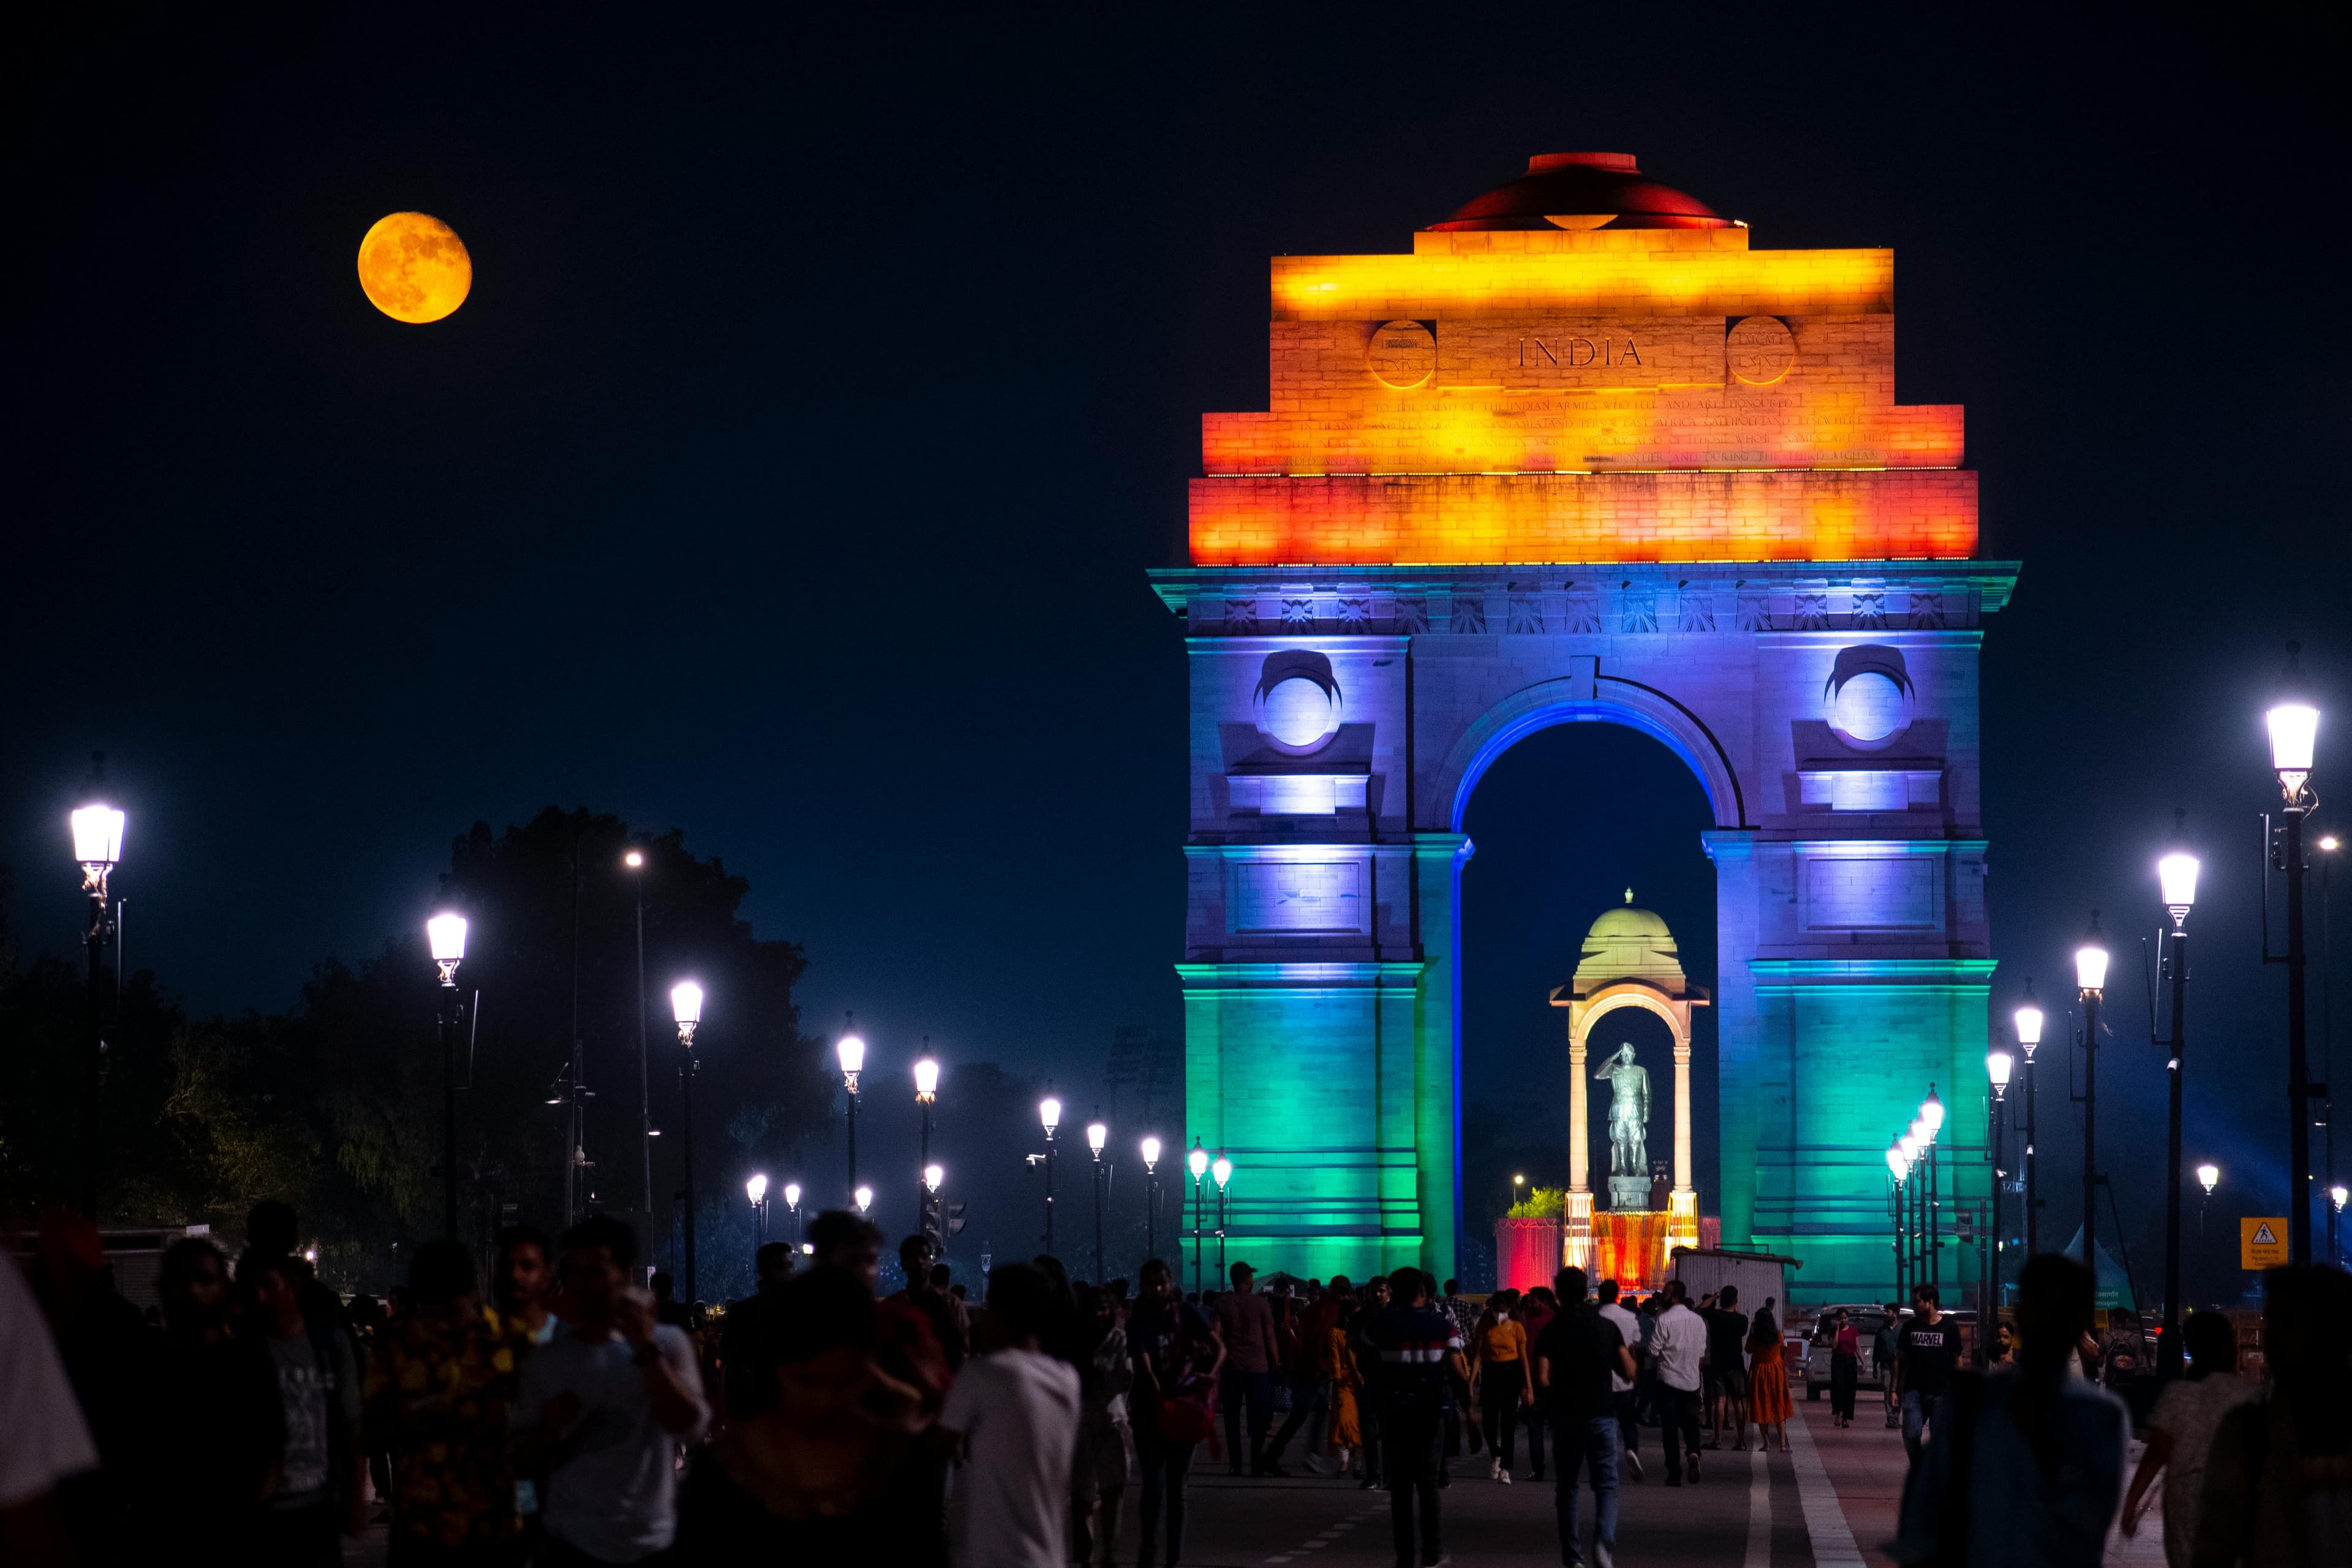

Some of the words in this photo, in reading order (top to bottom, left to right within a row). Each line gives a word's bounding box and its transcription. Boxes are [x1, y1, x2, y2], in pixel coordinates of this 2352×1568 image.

[1519, 337, 1642, 366] INDIA
[1375, 402, 1389, 412] TO
[1426, 402, 1457, 411] DEAD
[1462, 402, 1476, 411] OF
[1483, 402, 1503, 410] THE
[1510, 401, 1549, 410] INDIAN
[1556, 401, 1597, 410] ARMIES
[1602, 400, 1629, 409] WHO
[1665, 399, 1690, 409] AND
[1698, 399, 1719, 408] ARE
[1729, 399, 1793, 407] HONOURED
[1300, 421, 1311, 429] IN
[1548, 418, 1574, 428] AND
[1581, 418, 1617, 427] PERSIA
[1765, 417, 1790, 426] AND
[1831, 434, 1851, 442] ARE
[1255, 456, 1316, 466] RECORDED
[1323, 456, 1348, 465] AND
[1353, 455, 1381, 464] WHO
[1416, 454, 1427, 464] IN
[1436, 454, 1467, 464] INDIA
[1674, 452, 1698, 461] AND
[1705, 452, 1749, 461] DURING
[1911, 1333, 1941, 1345] MARVEL
